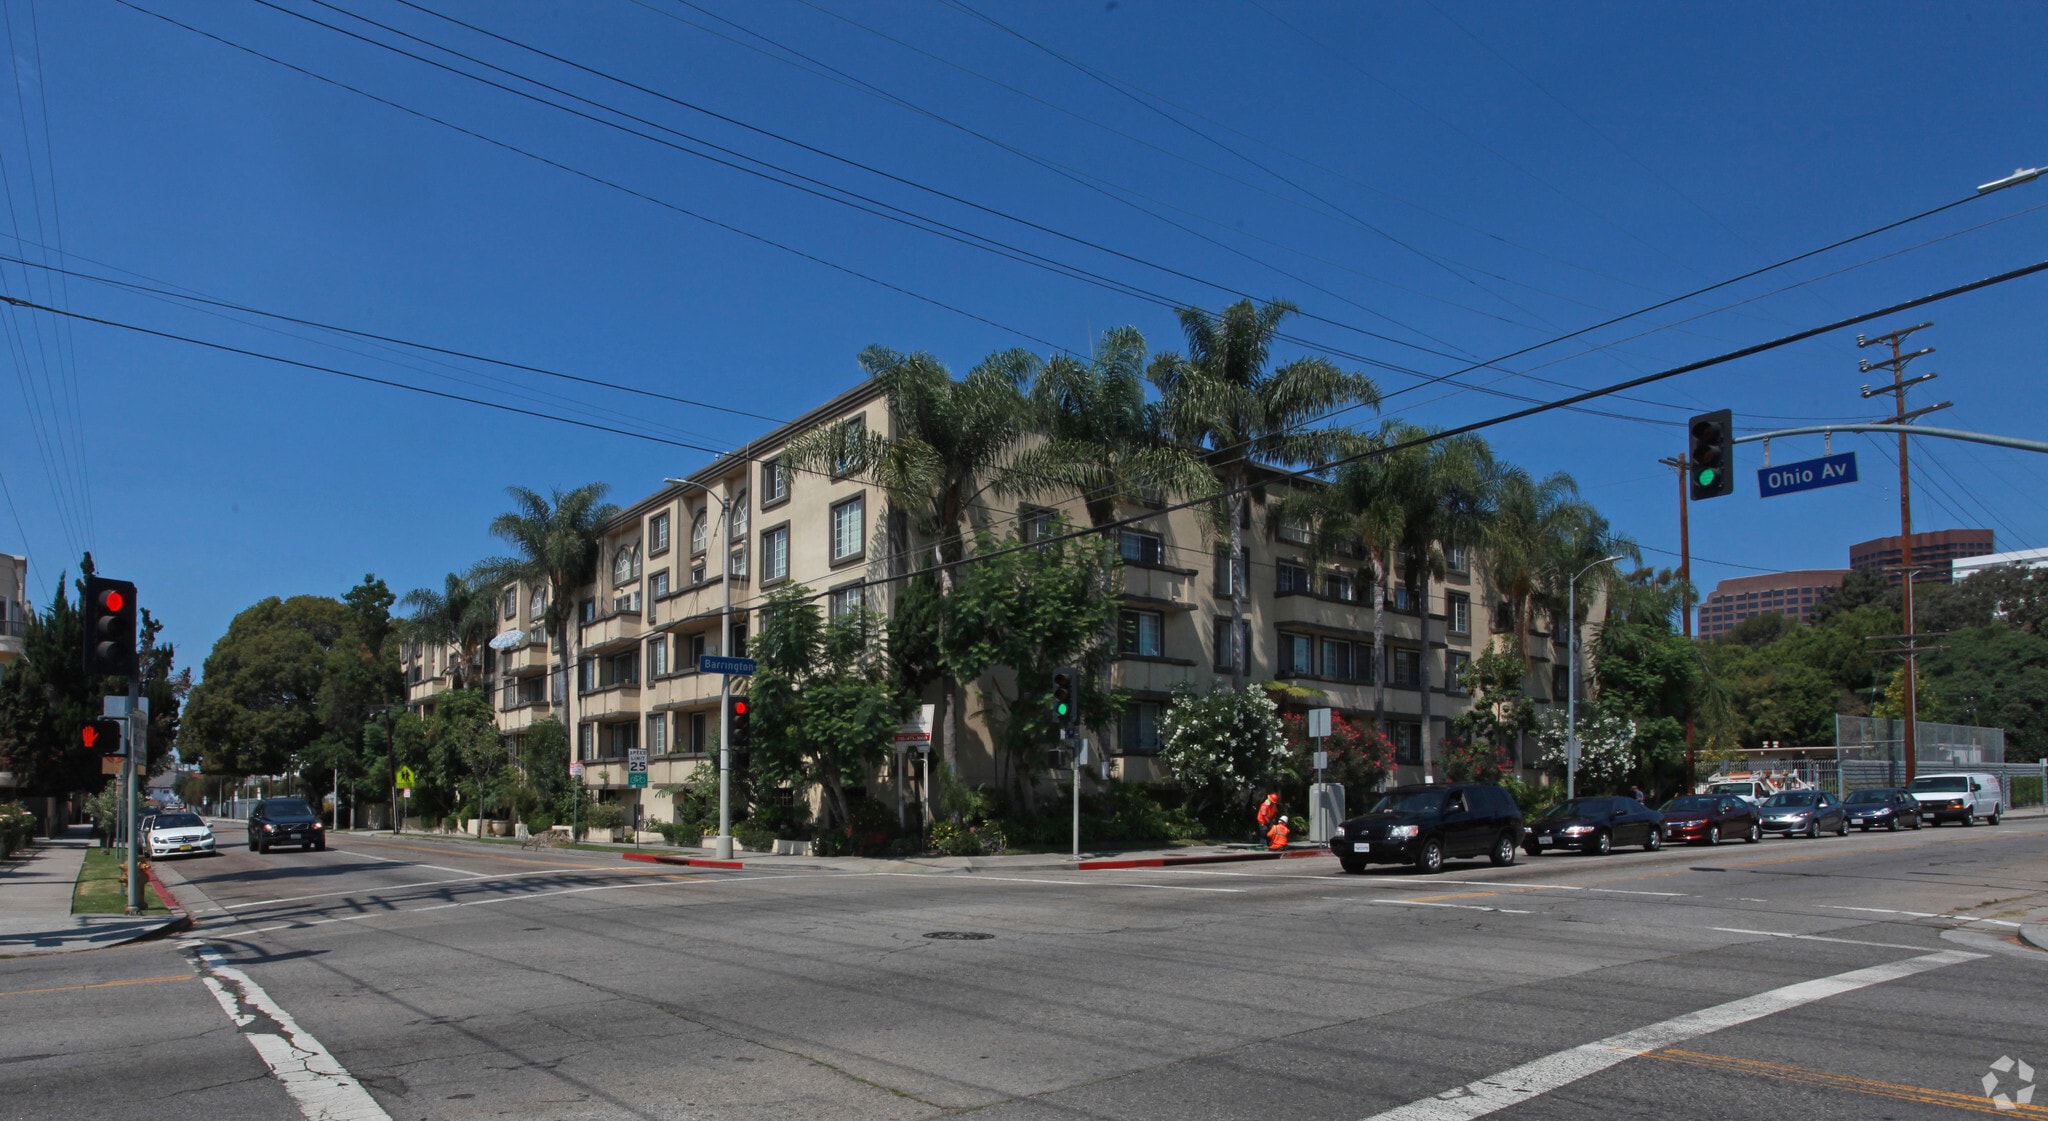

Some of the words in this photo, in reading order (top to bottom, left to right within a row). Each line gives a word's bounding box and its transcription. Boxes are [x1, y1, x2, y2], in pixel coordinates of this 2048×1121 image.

[1768, 468, 1813, 488] Ohio
[1821, 463, 1847, 479] Av
[704, 659, 754, 673] Barrington
[630, 762, 646, 771] 25
